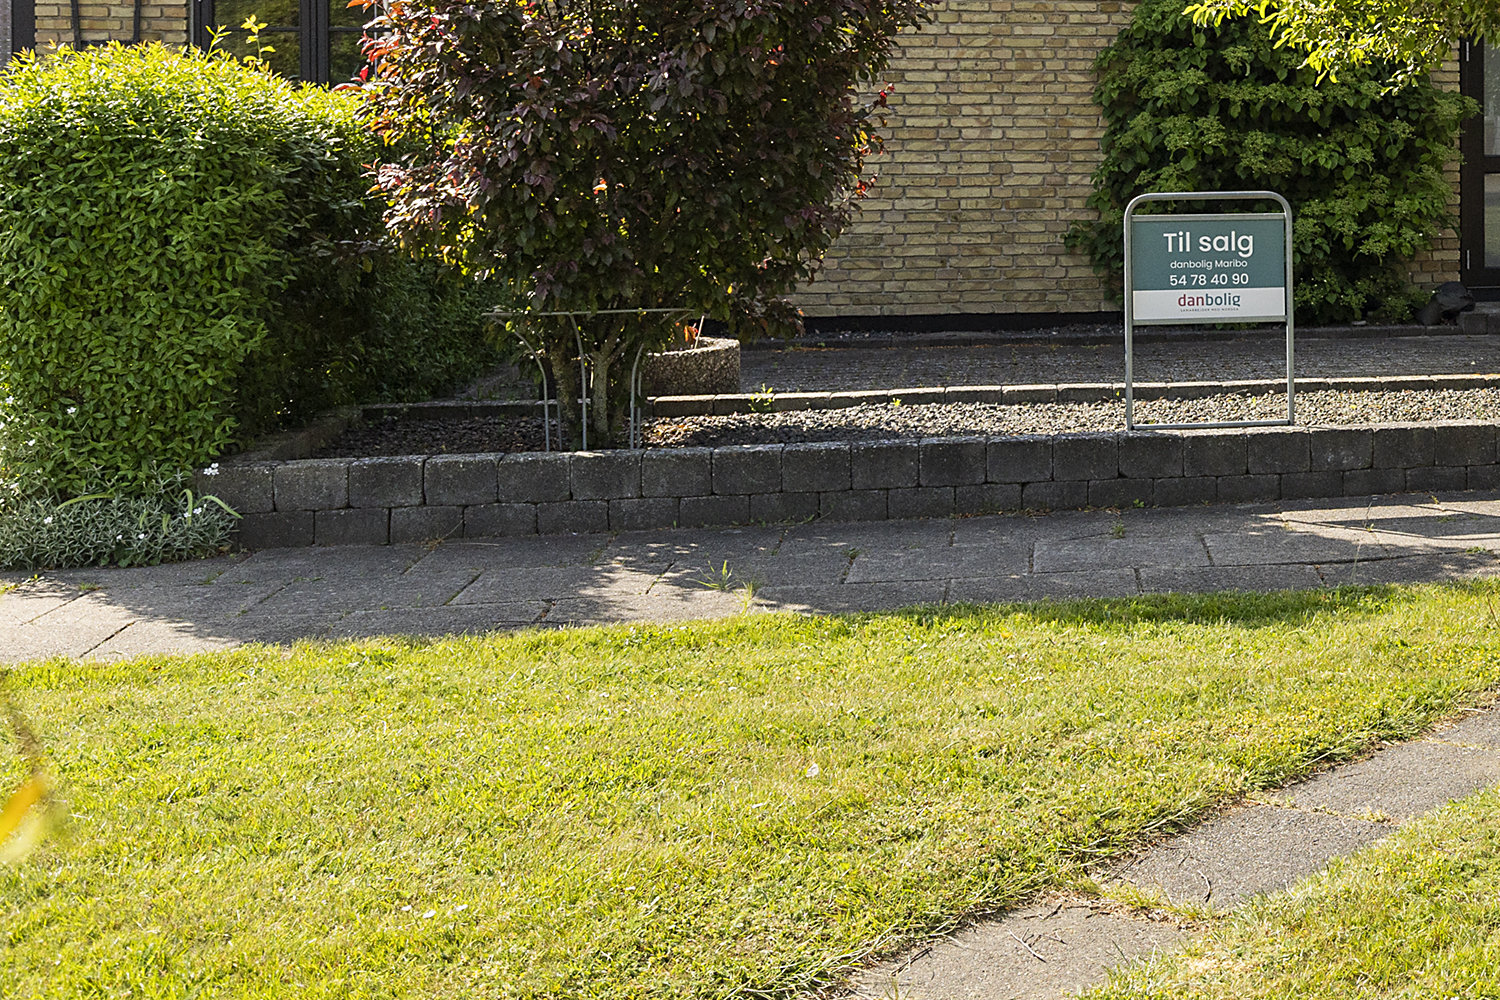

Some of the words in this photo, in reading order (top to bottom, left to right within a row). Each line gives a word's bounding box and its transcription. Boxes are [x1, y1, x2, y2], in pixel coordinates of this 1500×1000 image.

[1163, 231, 1191, 252] Til
[1199, 230, 1254, 258] salg
[1170, 260, 1213, 270] danbolig
[1214, 259, 1248, 268] Maribo
[1169, 274, 1187, 286] 54
[1190, 274, 1207, 286] 78
[1210, 273, 1228, 285] 40
[1231, 273, 1249, 285] 90
[1178, 293, 1241, 307] danbolig
